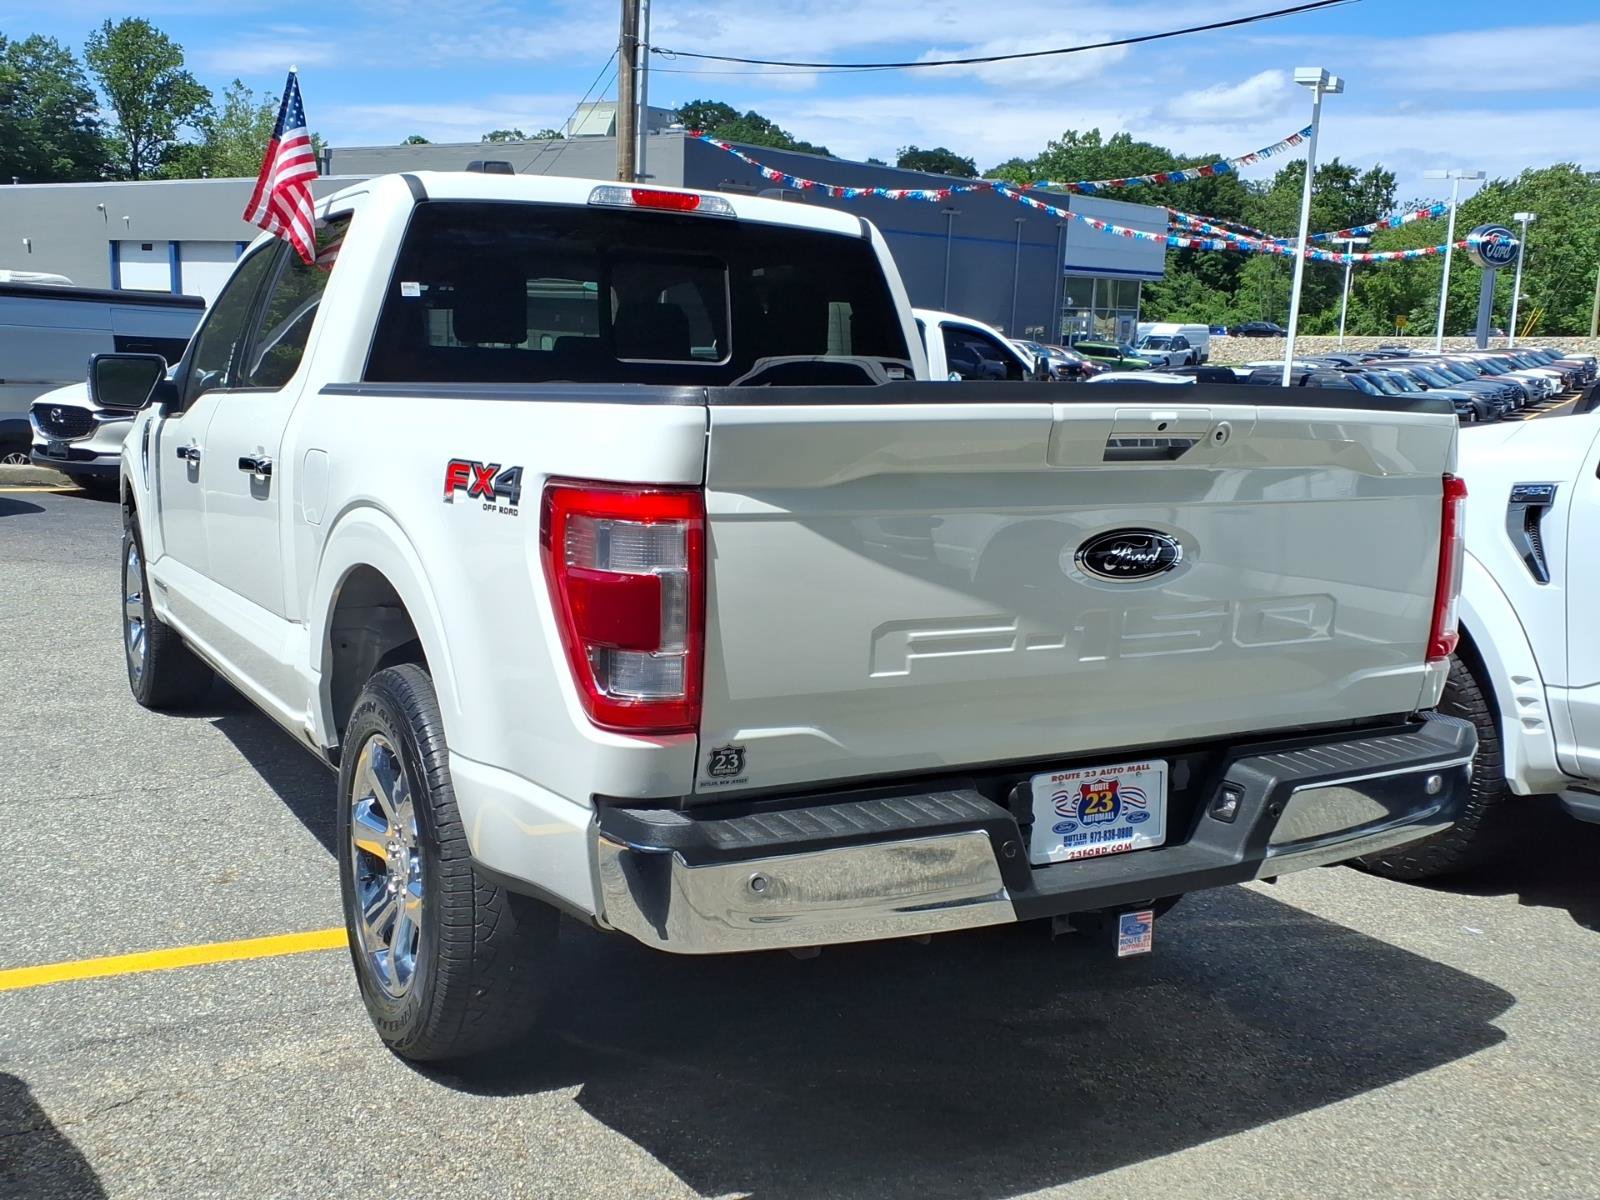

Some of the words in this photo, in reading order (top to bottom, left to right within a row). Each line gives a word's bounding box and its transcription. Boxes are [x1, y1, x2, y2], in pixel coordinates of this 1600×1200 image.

[443, 458, 524, 505] FX4
[482, 503, 497, 513] OFF
[499, 506, 519, 517] ROAD
[714, 753, 740, 770] 23
[1051, 773, 1081, 783] ROUTE
[1084, 770, 1097, 778] 23
[1099, 767, 1124, 776] AUTO
[1127, 763, 1151, 773] MALL
[1090, 782, 1110, 792] ROUTE
[1084, 791, 1114, 814] 23
[1083, 811, 1115, 823] AUTOMALL
[1069, 842, 1133, 860] 23FORD.COM
[1120, 935, 1142, 946] ROUTE
